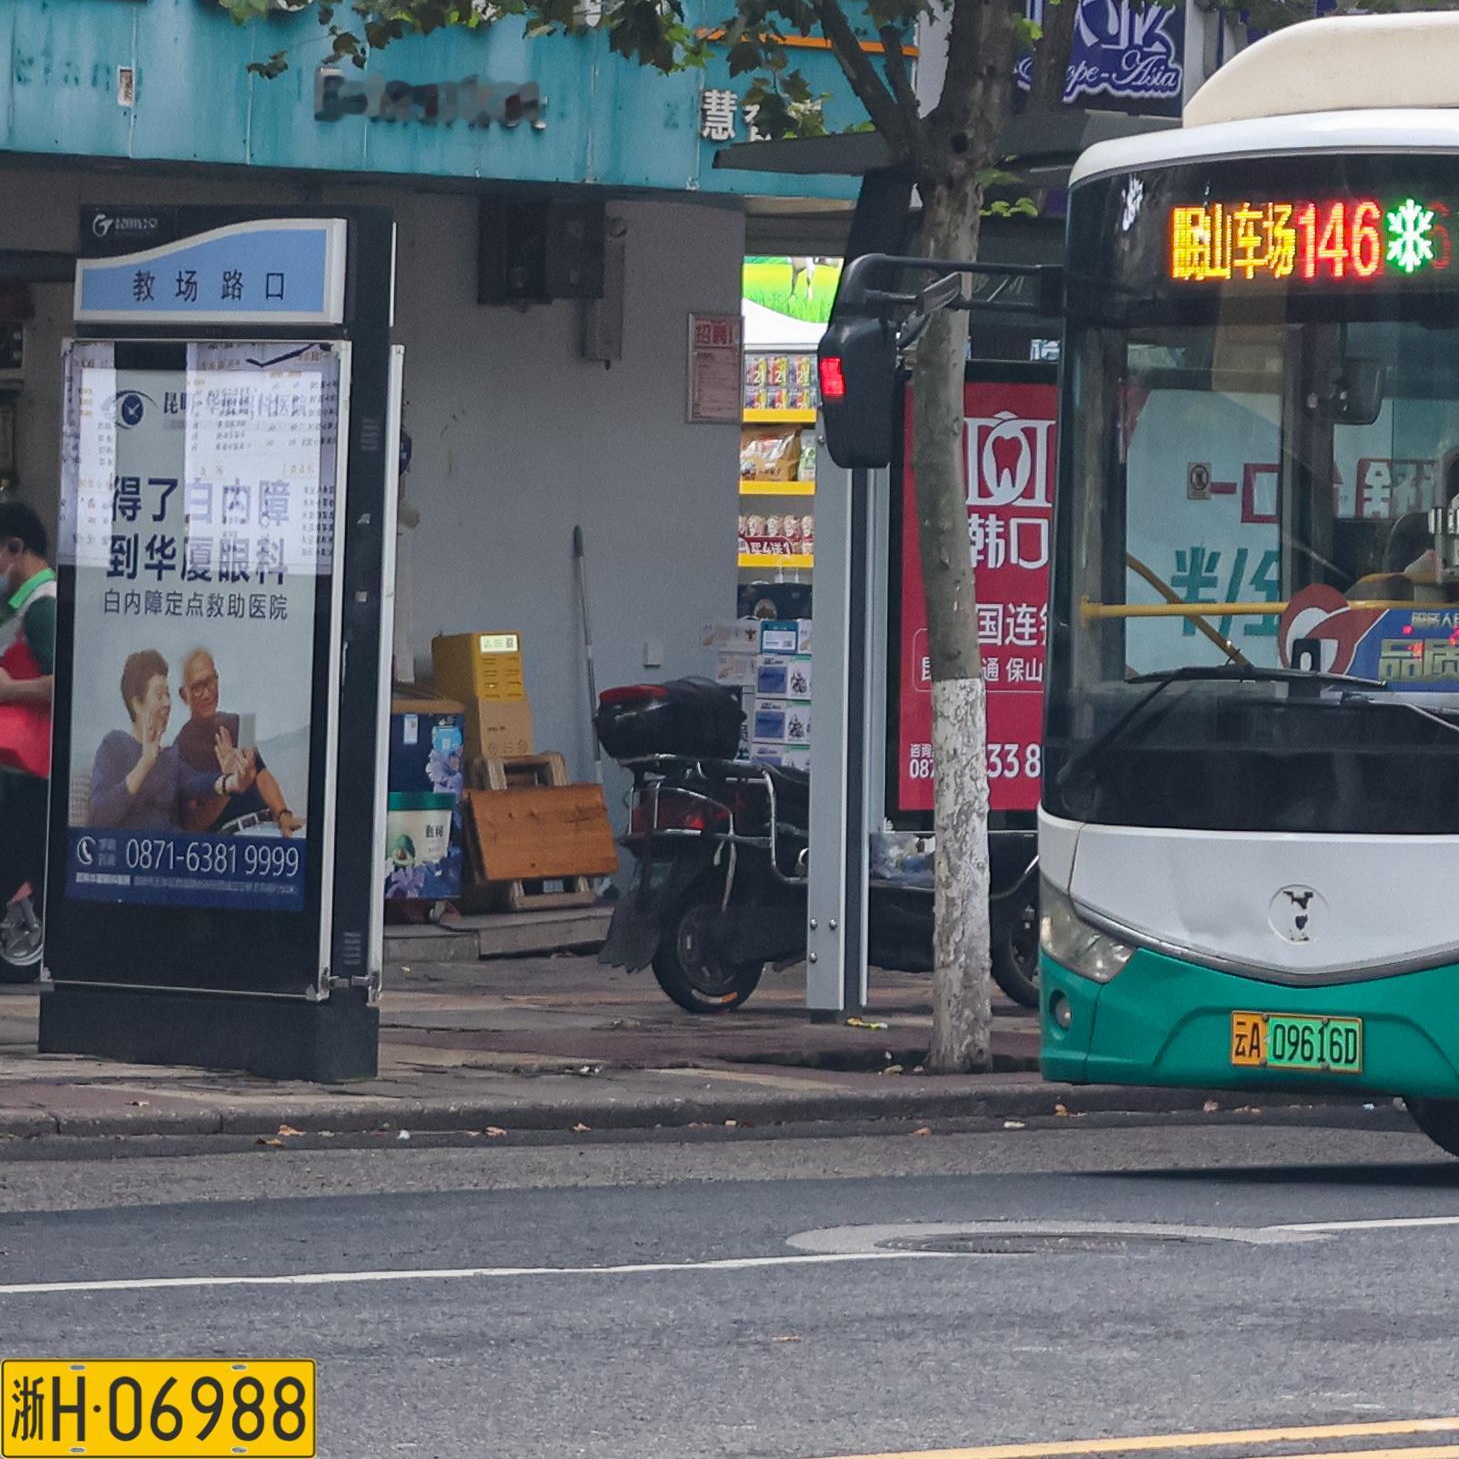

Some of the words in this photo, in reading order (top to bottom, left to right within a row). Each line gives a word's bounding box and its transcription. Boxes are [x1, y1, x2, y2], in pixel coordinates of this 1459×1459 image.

[1298, 202, 1381, 279] 146
[133, 270, 285, 302] 教场路口
[112, 475, 290, 527] 得了白内障
[106, 533, 289, 585] 到华厦眼科
[104, 588, 288, 621] 白内障定点救助医院
[1005, 657, 1043, 682] 保山
[126, 839, 237, 874] 0871-6381
[244, 844, 299, 877] 9999
